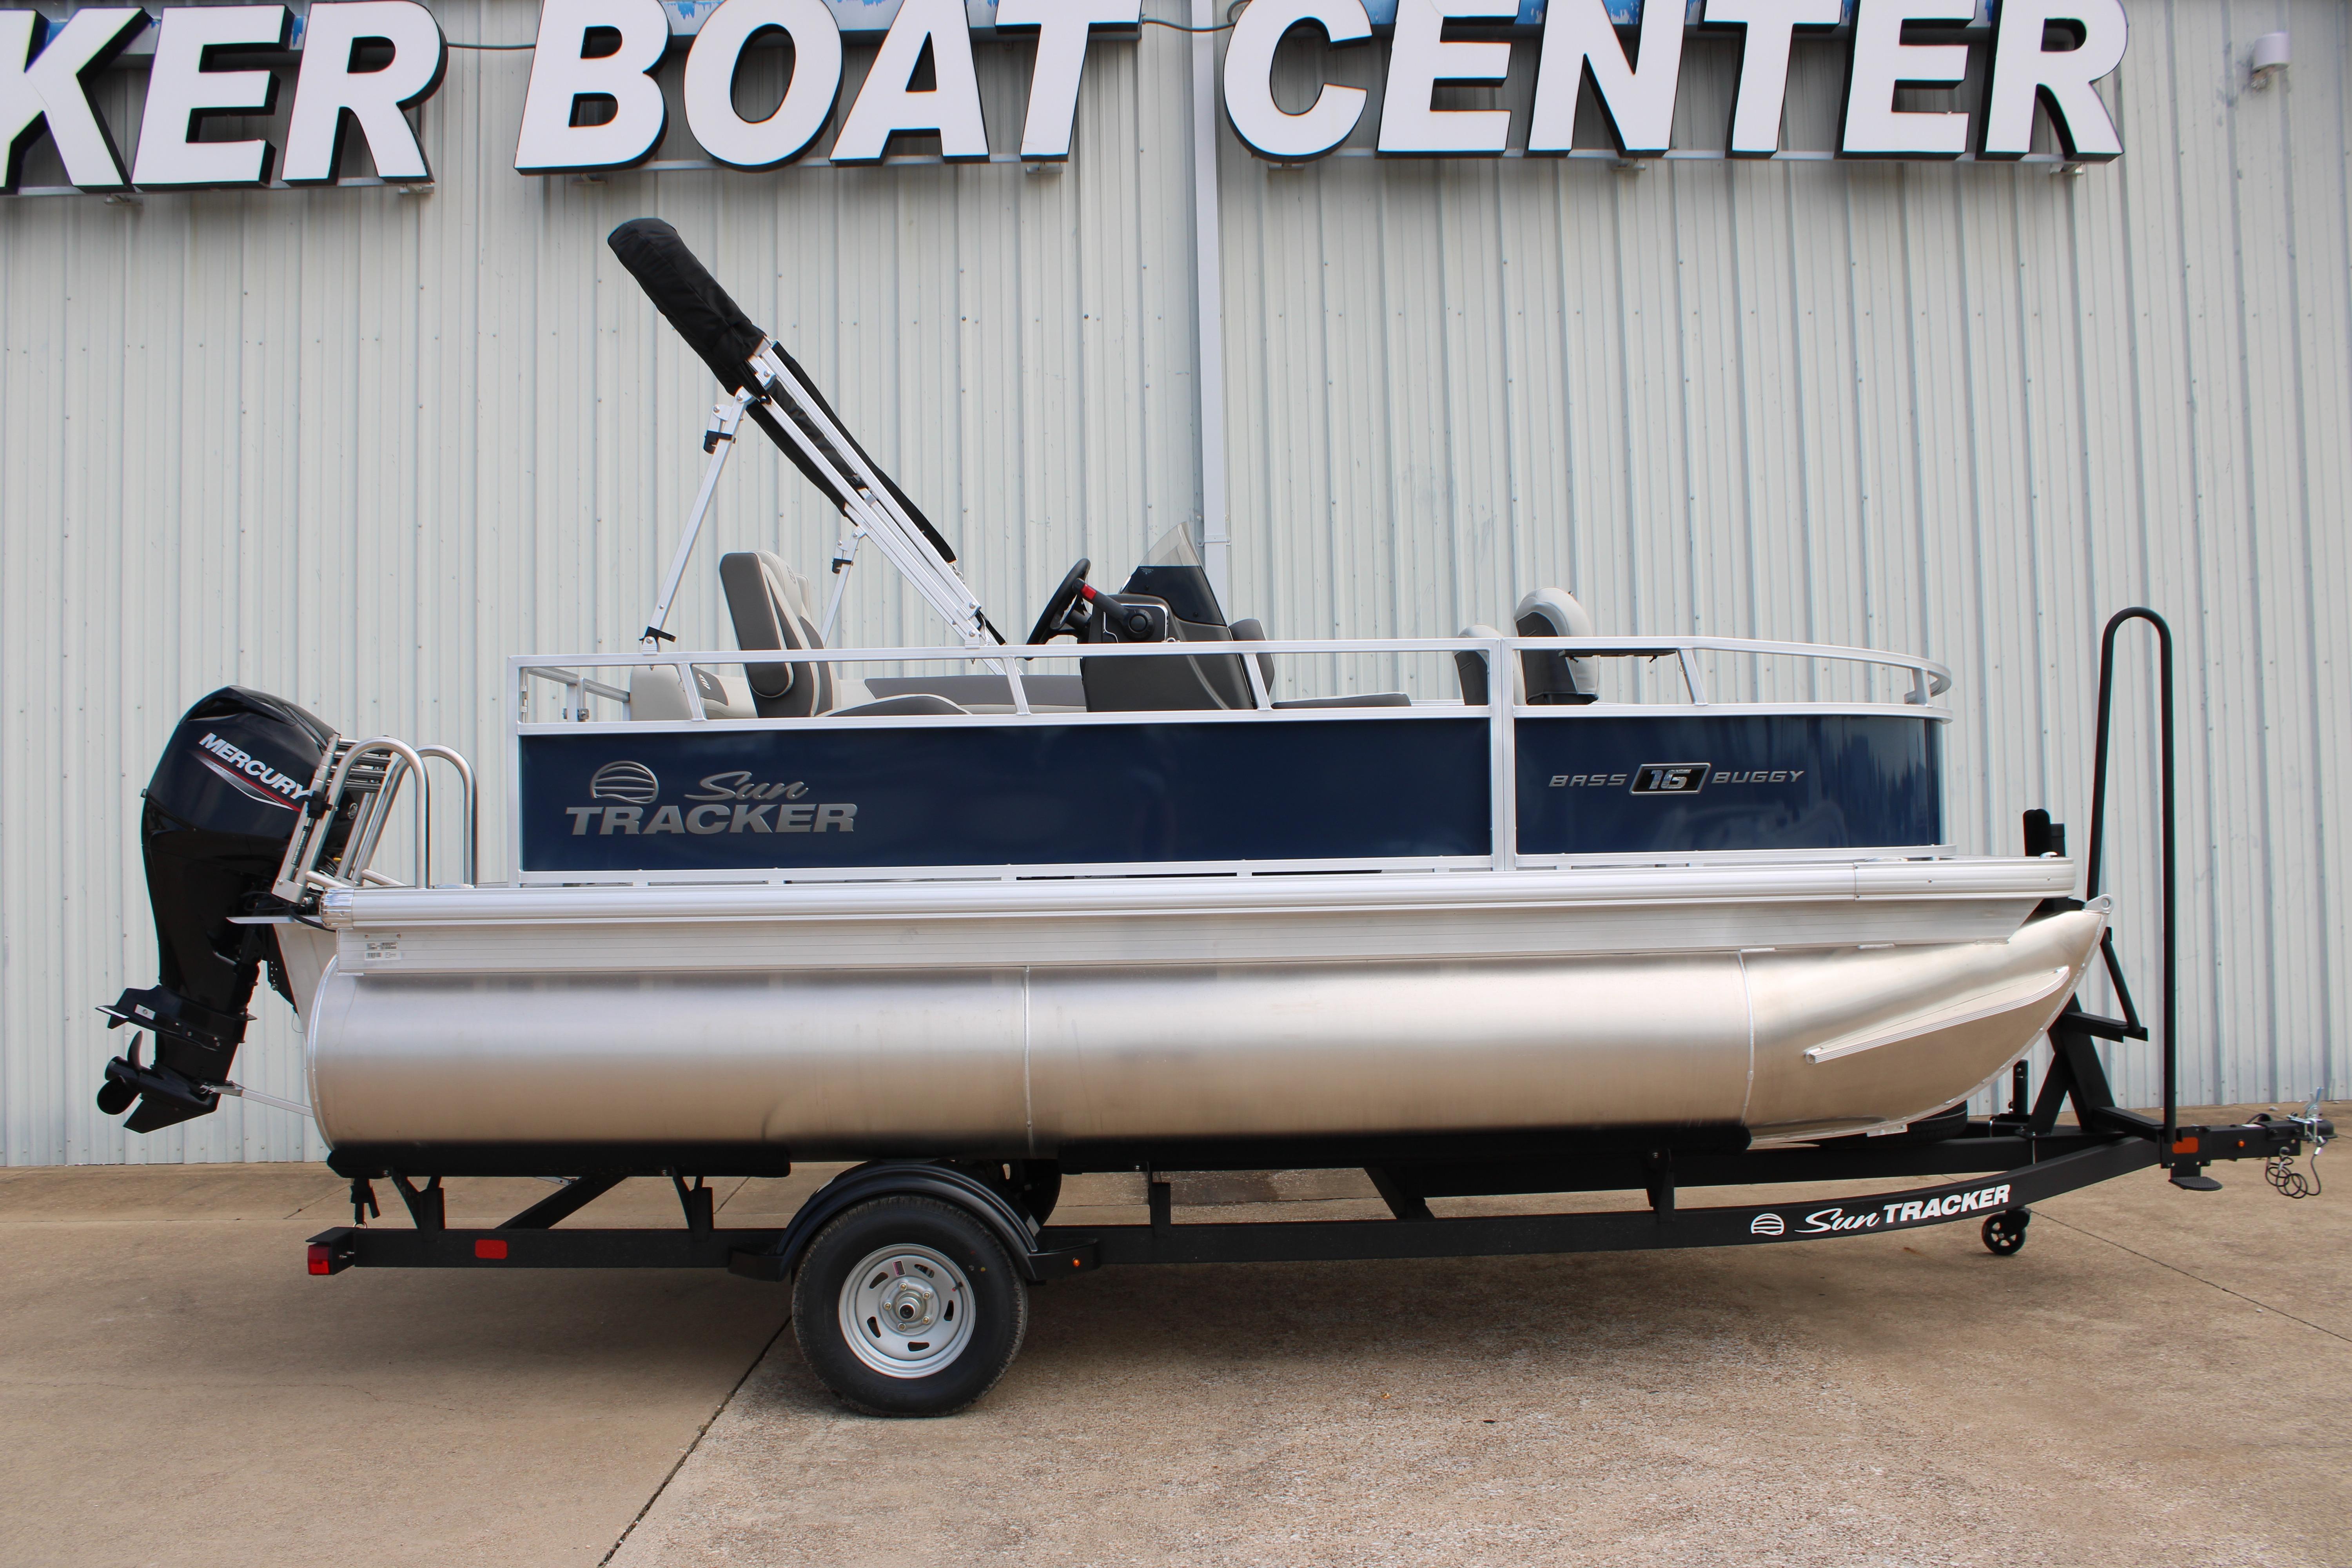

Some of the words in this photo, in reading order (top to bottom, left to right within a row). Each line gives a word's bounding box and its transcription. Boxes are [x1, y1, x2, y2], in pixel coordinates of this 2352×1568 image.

[513, 0, 1143, 173] BOAT
[1223, 0, 2129, 163] CENTER
[199, 732, 311, 800] MERCURY
[684, 771, 809, 800] Sun
[1548, 774, 1628, 787] BASS
[1648, 769, 1692, 789] 16
[1711, 771, 1804, 784] BUGGY
[565, 803, 858, 836] TRACKER
[1794, 1208, 1880, 1233] Sun
[1883, 1184, 2011, 1224] TRACKER
